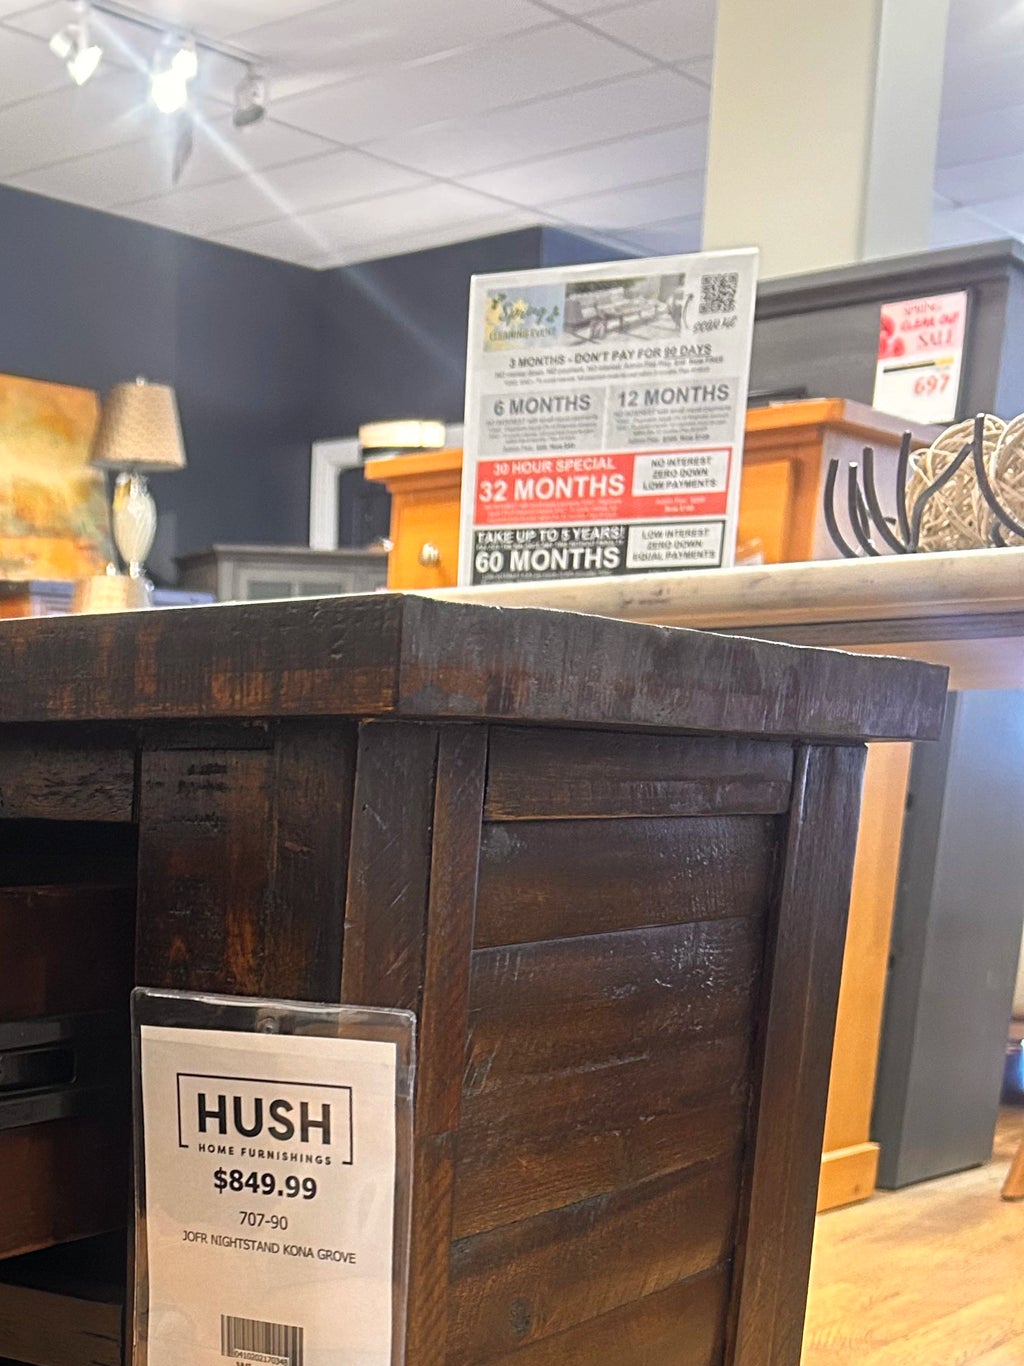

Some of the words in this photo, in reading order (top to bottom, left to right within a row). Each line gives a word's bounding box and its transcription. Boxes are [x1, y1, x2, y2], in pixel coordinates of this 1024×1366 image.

[518, 354, 565, 368] MONTHS
[575, 351, 609, 364] DON'T
[612, 349, 635, 361] PAY
[637, 347, 662, 359] FOR
[680, 343, 712, 356] DAYS
[619, 390, 638, 408] 12
[644, 384, 729, 406] MONTHS
[914, 373, 951, 396] 697
[494, 400, 504, 417] 6
[509, 394, 591, 415] MONTHS
[512, 459, 553, 474] HOUR
[556, 456, 616, 472] SPECIAL
[651, 458, 665, 468] NO
[666, 456, 712, 467] INTEREST
[479, 480, 508, 502] 32
[514, 473, 625, 501] MONTHS
[478, 530, 515, 545] TAKE
[516, 529, 537, 543] UP
[540, 529, 559, 542] TO
[561, 528, 571, 541] 5
[573, 526, 626, 541] YEARS!
[475, 550, 504, 573] 60
[510, 546, 621, 572] MONTHS
[197, 1092, 331, 1145] HUSH
[198, 1143, 235, 1156] HOME
[240, 1147, 332, 1166] FURNISHINGS
[213, 1167, 317, 1200] $849.99
[239, 1211, 288, 1231] 707-90
[182, 1230, 207, 1245] JOFR
[210, 1234, 280, 1254] NIGHTSTAND
[283, 1243, 314, 1259] KONA
[317, 1248, 356, 1264] GROVE
